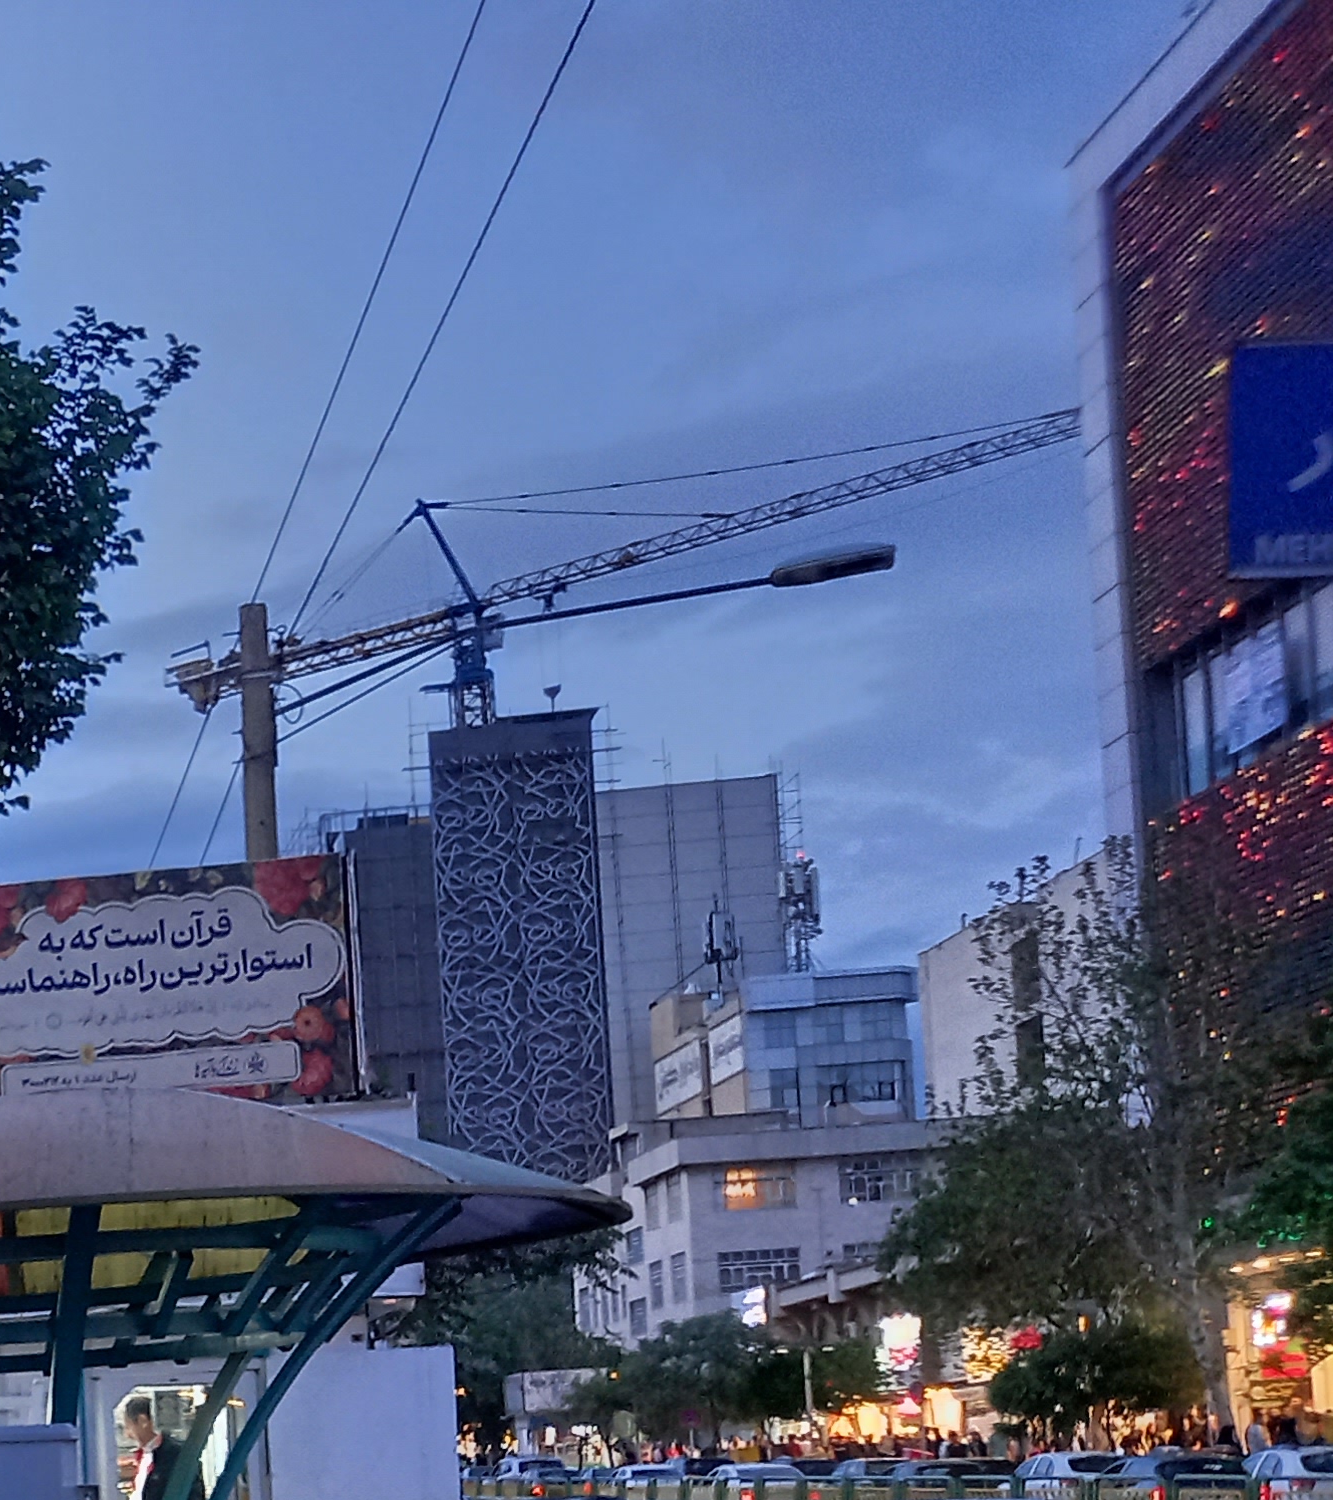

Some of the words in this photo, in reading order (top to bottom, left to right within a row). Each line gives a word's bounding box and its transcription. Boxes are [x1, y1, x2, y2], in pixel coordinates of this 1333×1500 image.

[70, 924, 104, 950] که
[104, 919, 166, 949] است
[171, 908, 232, 948] قرآن
[38, 932, 66, 961] به
[159, 943, 313, 990] استوارترین
